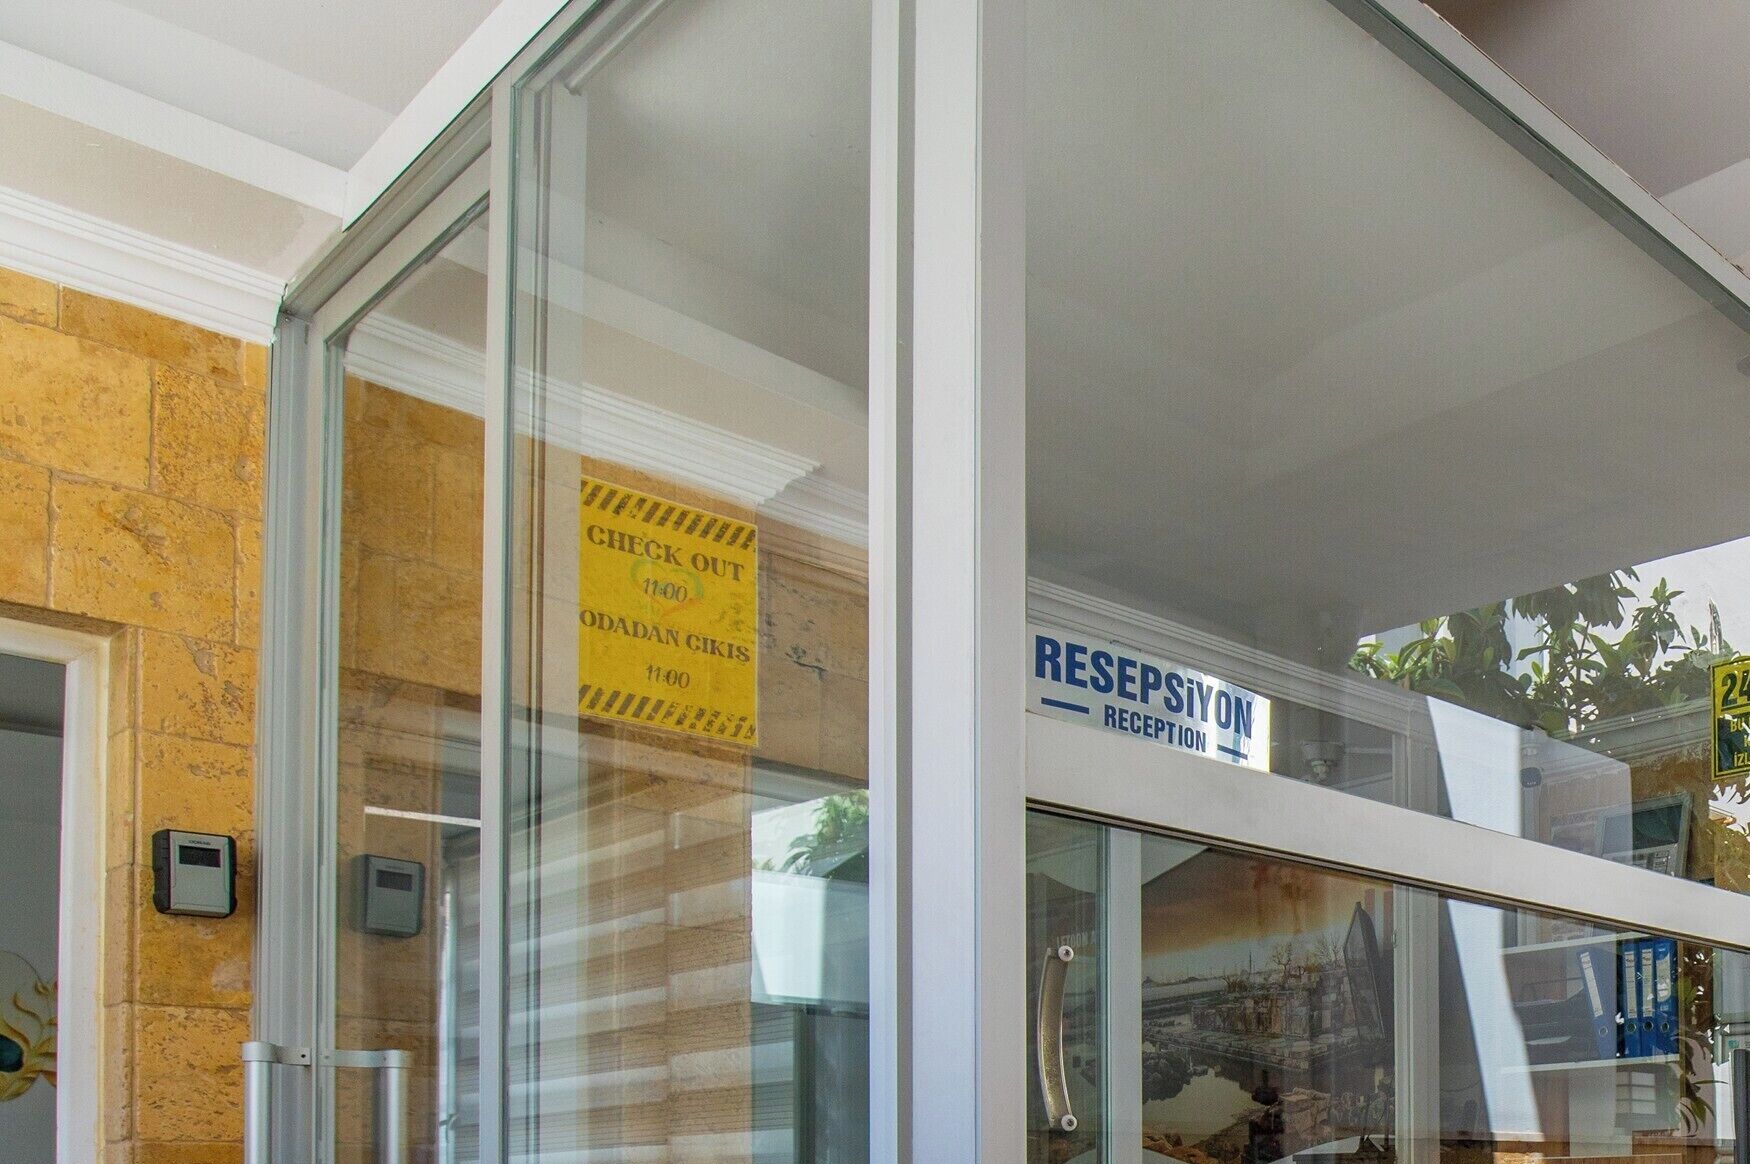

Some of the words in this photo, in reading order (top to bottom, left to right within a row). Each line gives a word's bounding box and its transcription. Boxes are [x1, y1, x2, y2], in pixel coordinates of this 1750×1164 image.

[586, 524, 682, 568] CHECK
[690, 552, 745, 583] OUT
[642, 577, 688, 605] 11:00
[579, 609, 680, 648] ODADAN
[646, 664, 691, 690] 11:00
[1104, 704, 1207, 753] RECEPTION
[1730, 717, 1745, 732] BU
